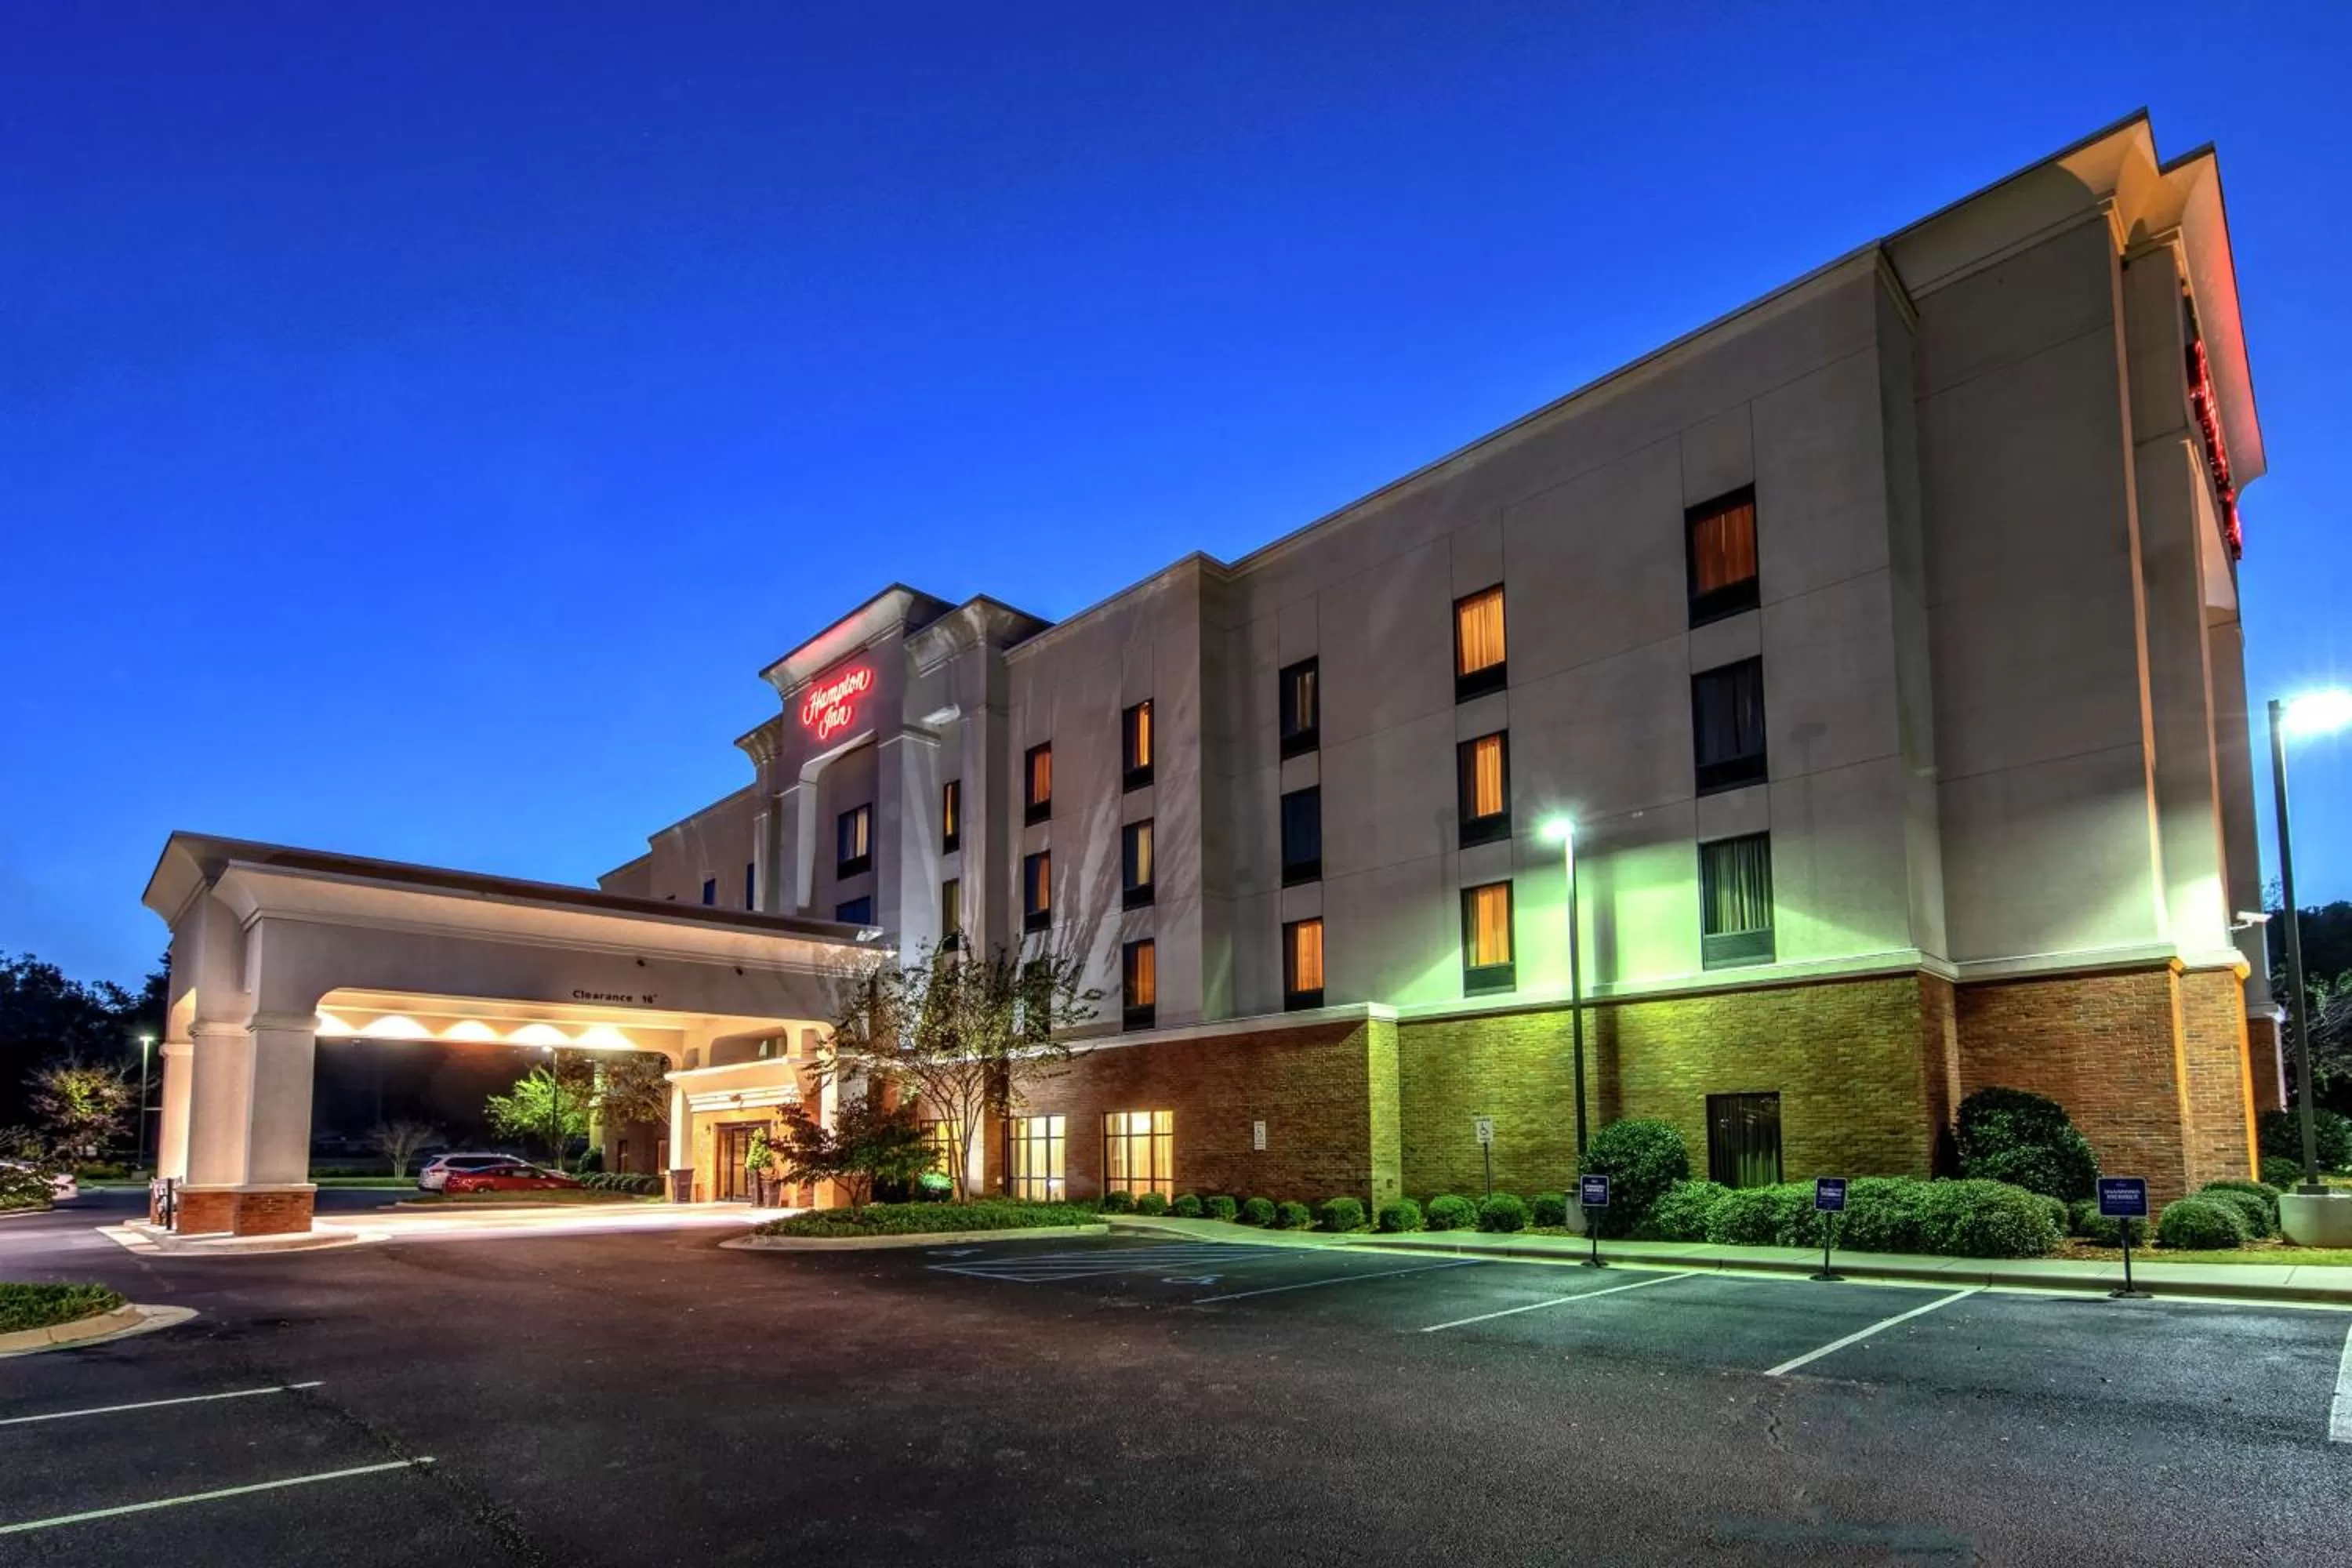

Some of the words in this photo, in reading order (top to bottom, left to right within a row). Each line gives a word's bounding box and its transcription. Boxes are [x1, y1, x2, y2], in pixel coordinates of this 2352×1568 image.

[803, 670, 870, 724] Hampton
[818, 705, 851, 739] Inn
[572, 990, 633, 1003] Clearance
